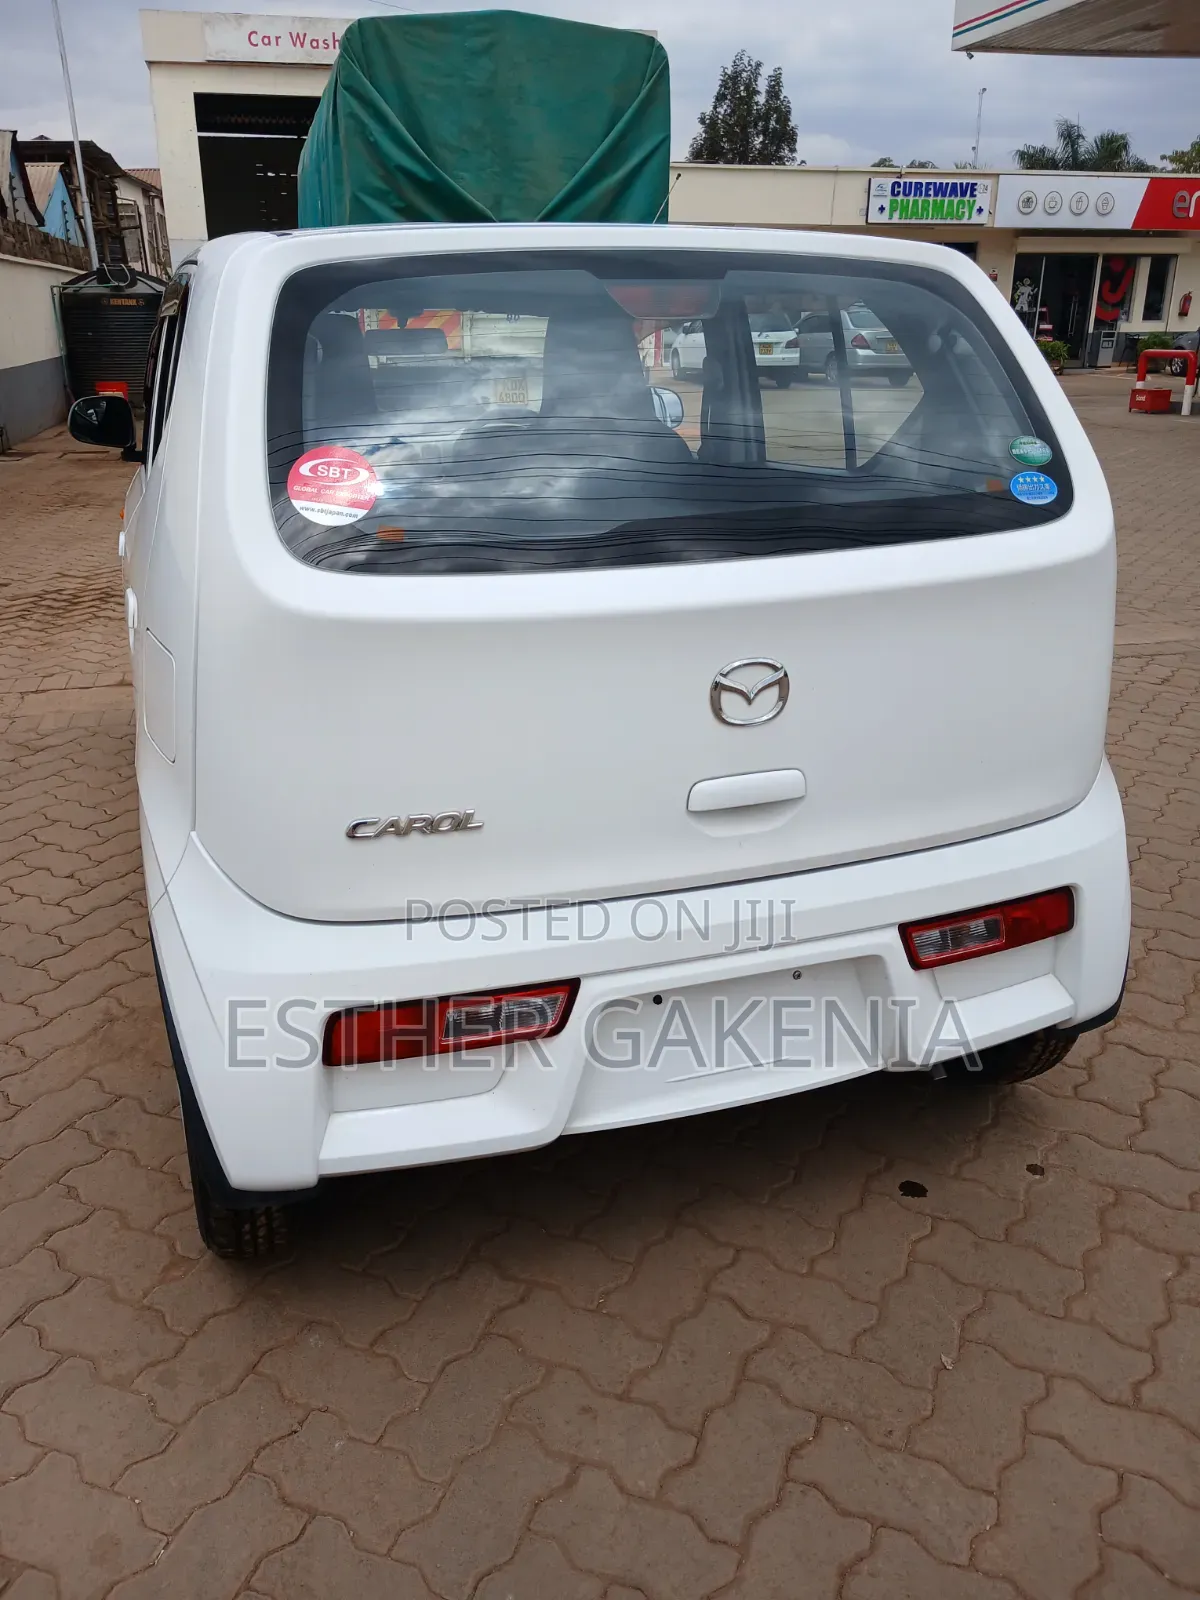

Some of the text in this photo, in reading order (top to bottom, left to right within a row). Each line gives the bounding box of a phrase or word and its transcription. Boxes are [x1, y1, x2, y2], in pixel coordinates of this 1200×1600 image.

[247, 30, 340, 50] Car Wash
[890, 181, 978, 198] CUREWAVE
[887, 198, 977, 220] PHARMACY
[317, 464, 352, 480] SBT
[346, 808, 484, 840] CAROL
